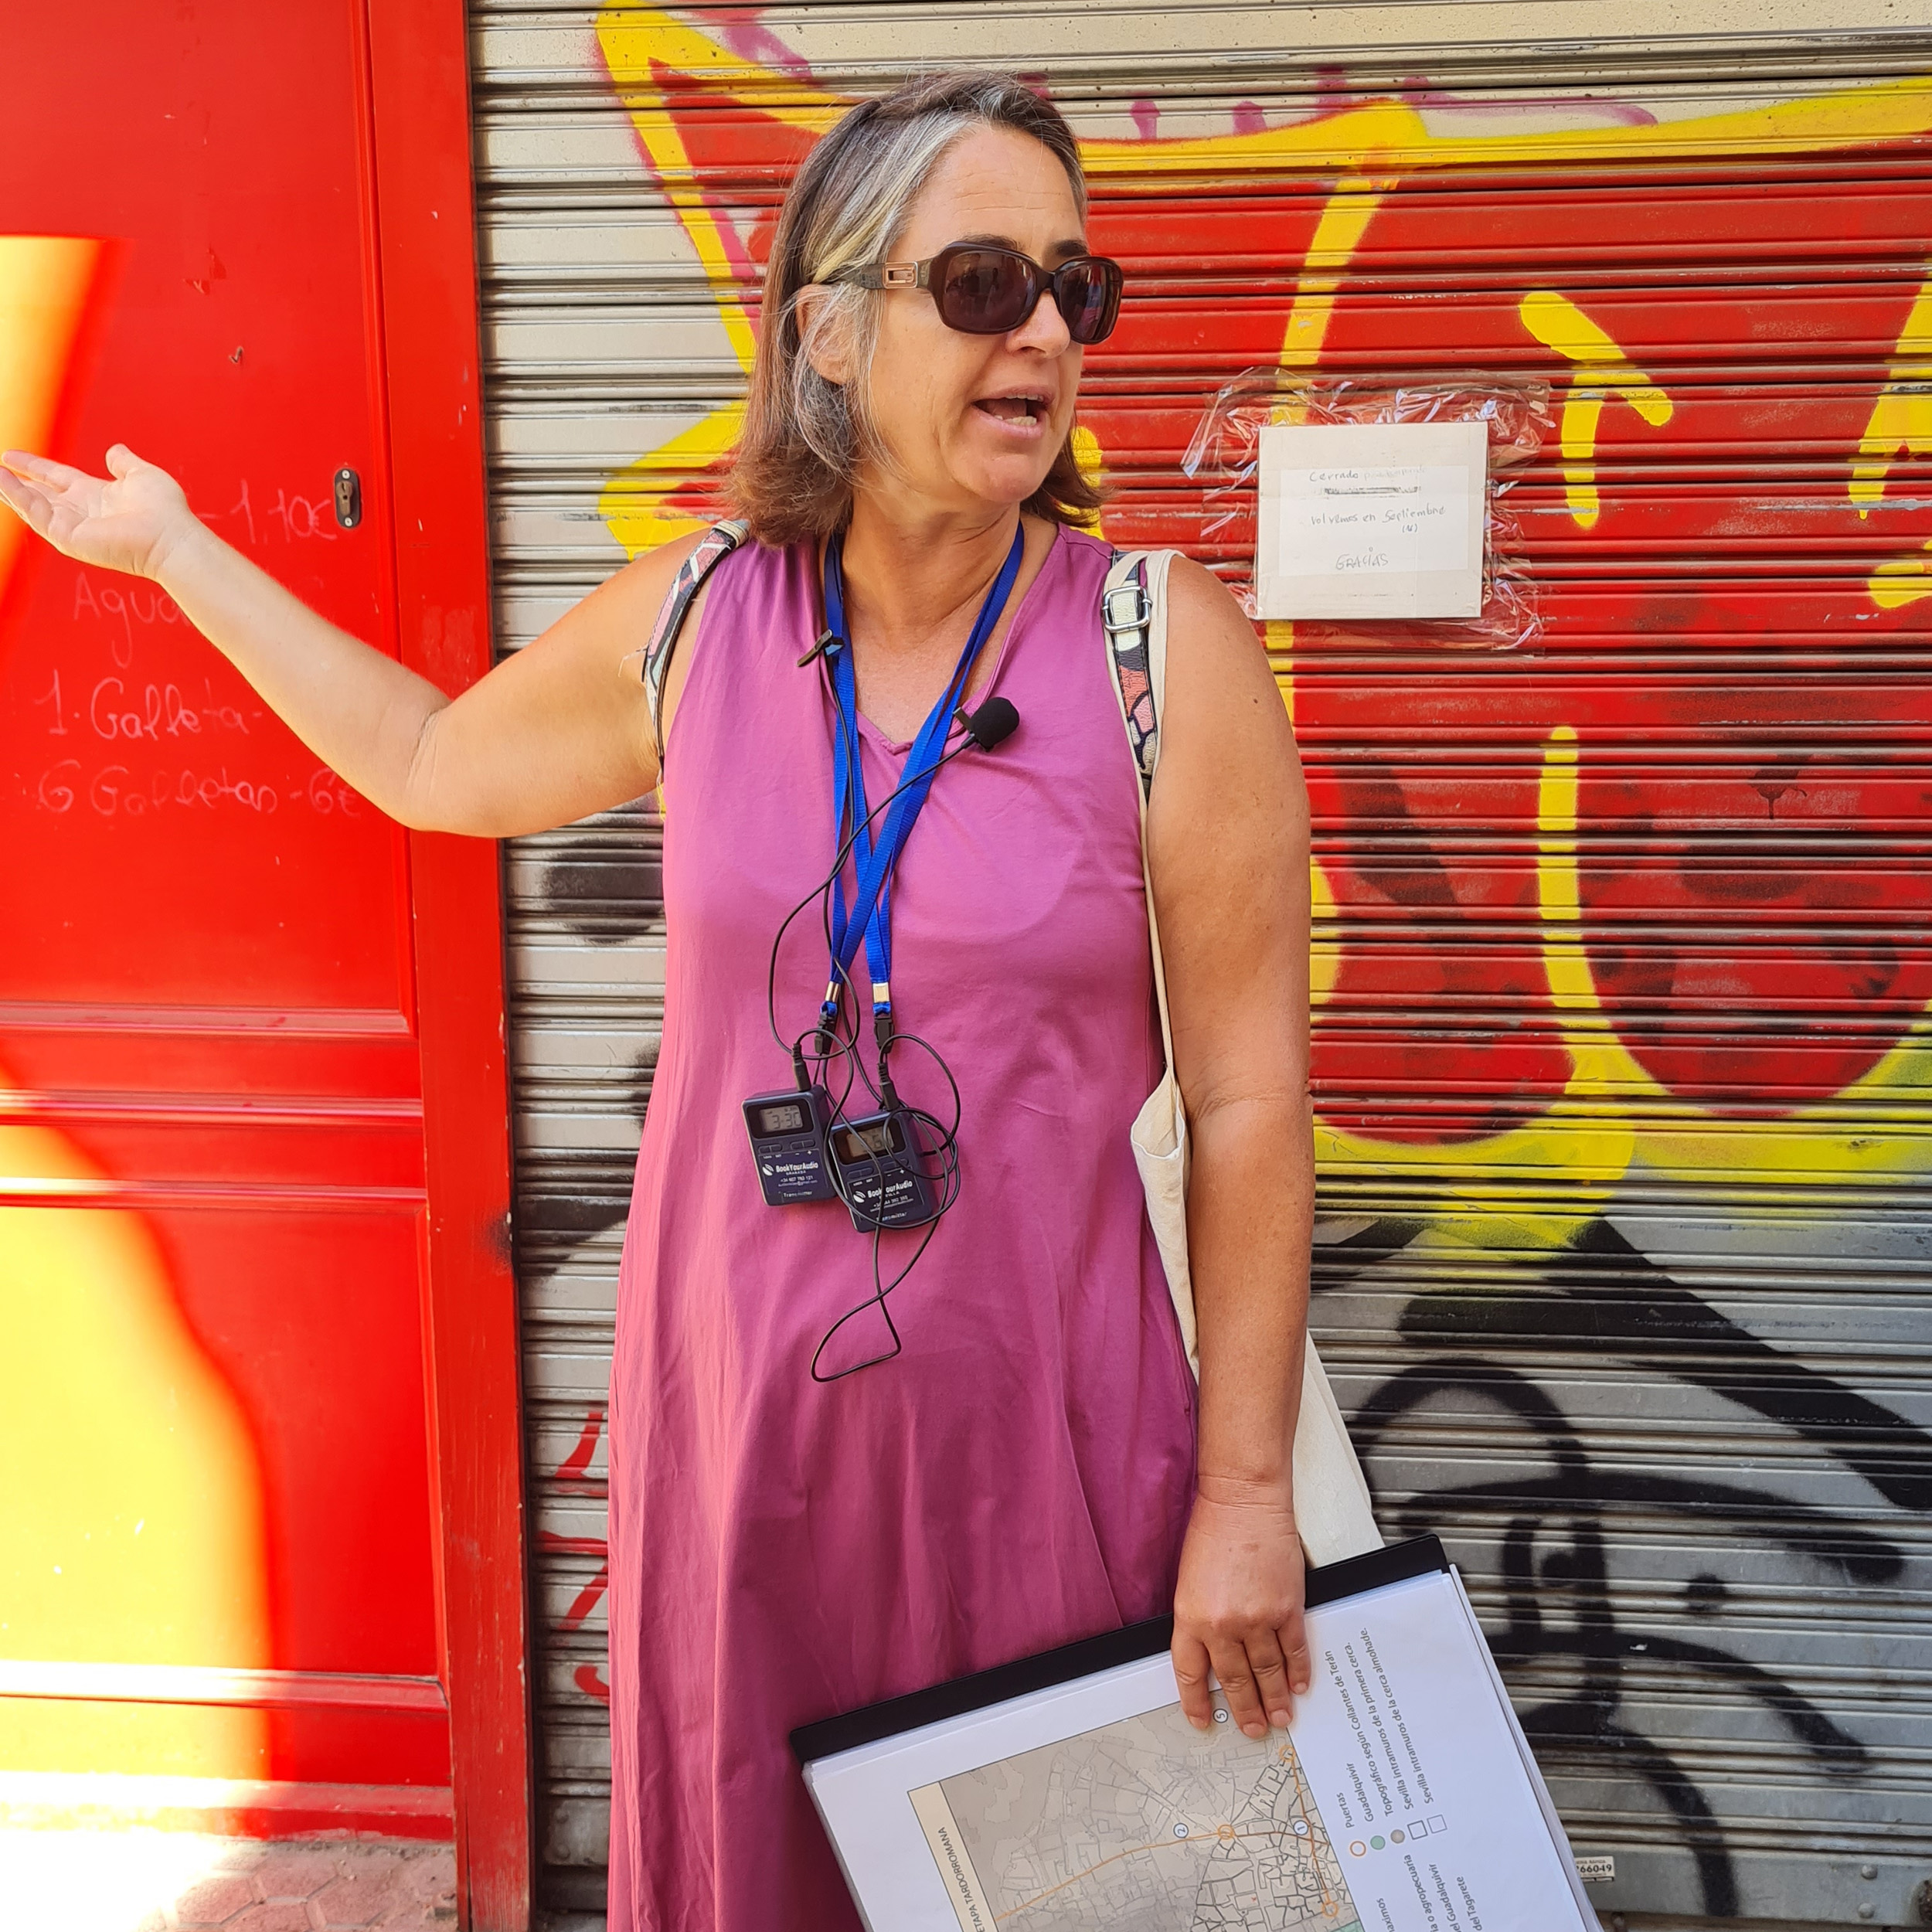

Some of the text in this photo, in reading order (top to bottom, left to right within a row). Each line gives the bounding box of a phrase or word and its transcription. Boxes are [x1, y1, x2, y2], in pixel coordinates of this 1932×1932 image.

[1309, 470, 1359, 481] Cerrado
[775, 1161, 819, 1173] BookYourAudio
[867, 1180, 913, 1198] BookourAudio
[1355, 1669, 1375, 1703] primera
[1379, 1675, 1393, 1698] cerca
[1368, 1706, 1377, 1714] la
[1372, 1715, 1382, 1726] de
[1388, 1699, 1396, 1708] la
[1392, 1709, 1401, 1721] de
[1325, 1651, 1393, 1817] Topográfico según Collantes de Terán
[1398, 1723, 1421, 1772] intramuros
[1378, 1728, 1402, 1778] intramuros
[1346, 1764, 1373, 1821] Guadalquivir
[1397, 1780, 1413, 1809] Sevilla
[1417, 1774, 1434, 1804] Sevilla
[1337, 1793, 1355, 1828] Puertas
[938, 1827, 973, 1904] TARDORROMANA
[1404, 1855, 1432, 1913] agropecuaria
[1429, 1864, 1456, 1921] Guadalquivir
[1376, 1898, 1395, 1932] aximos
[1457, 1876, 1482, 1930] del Tagarete
